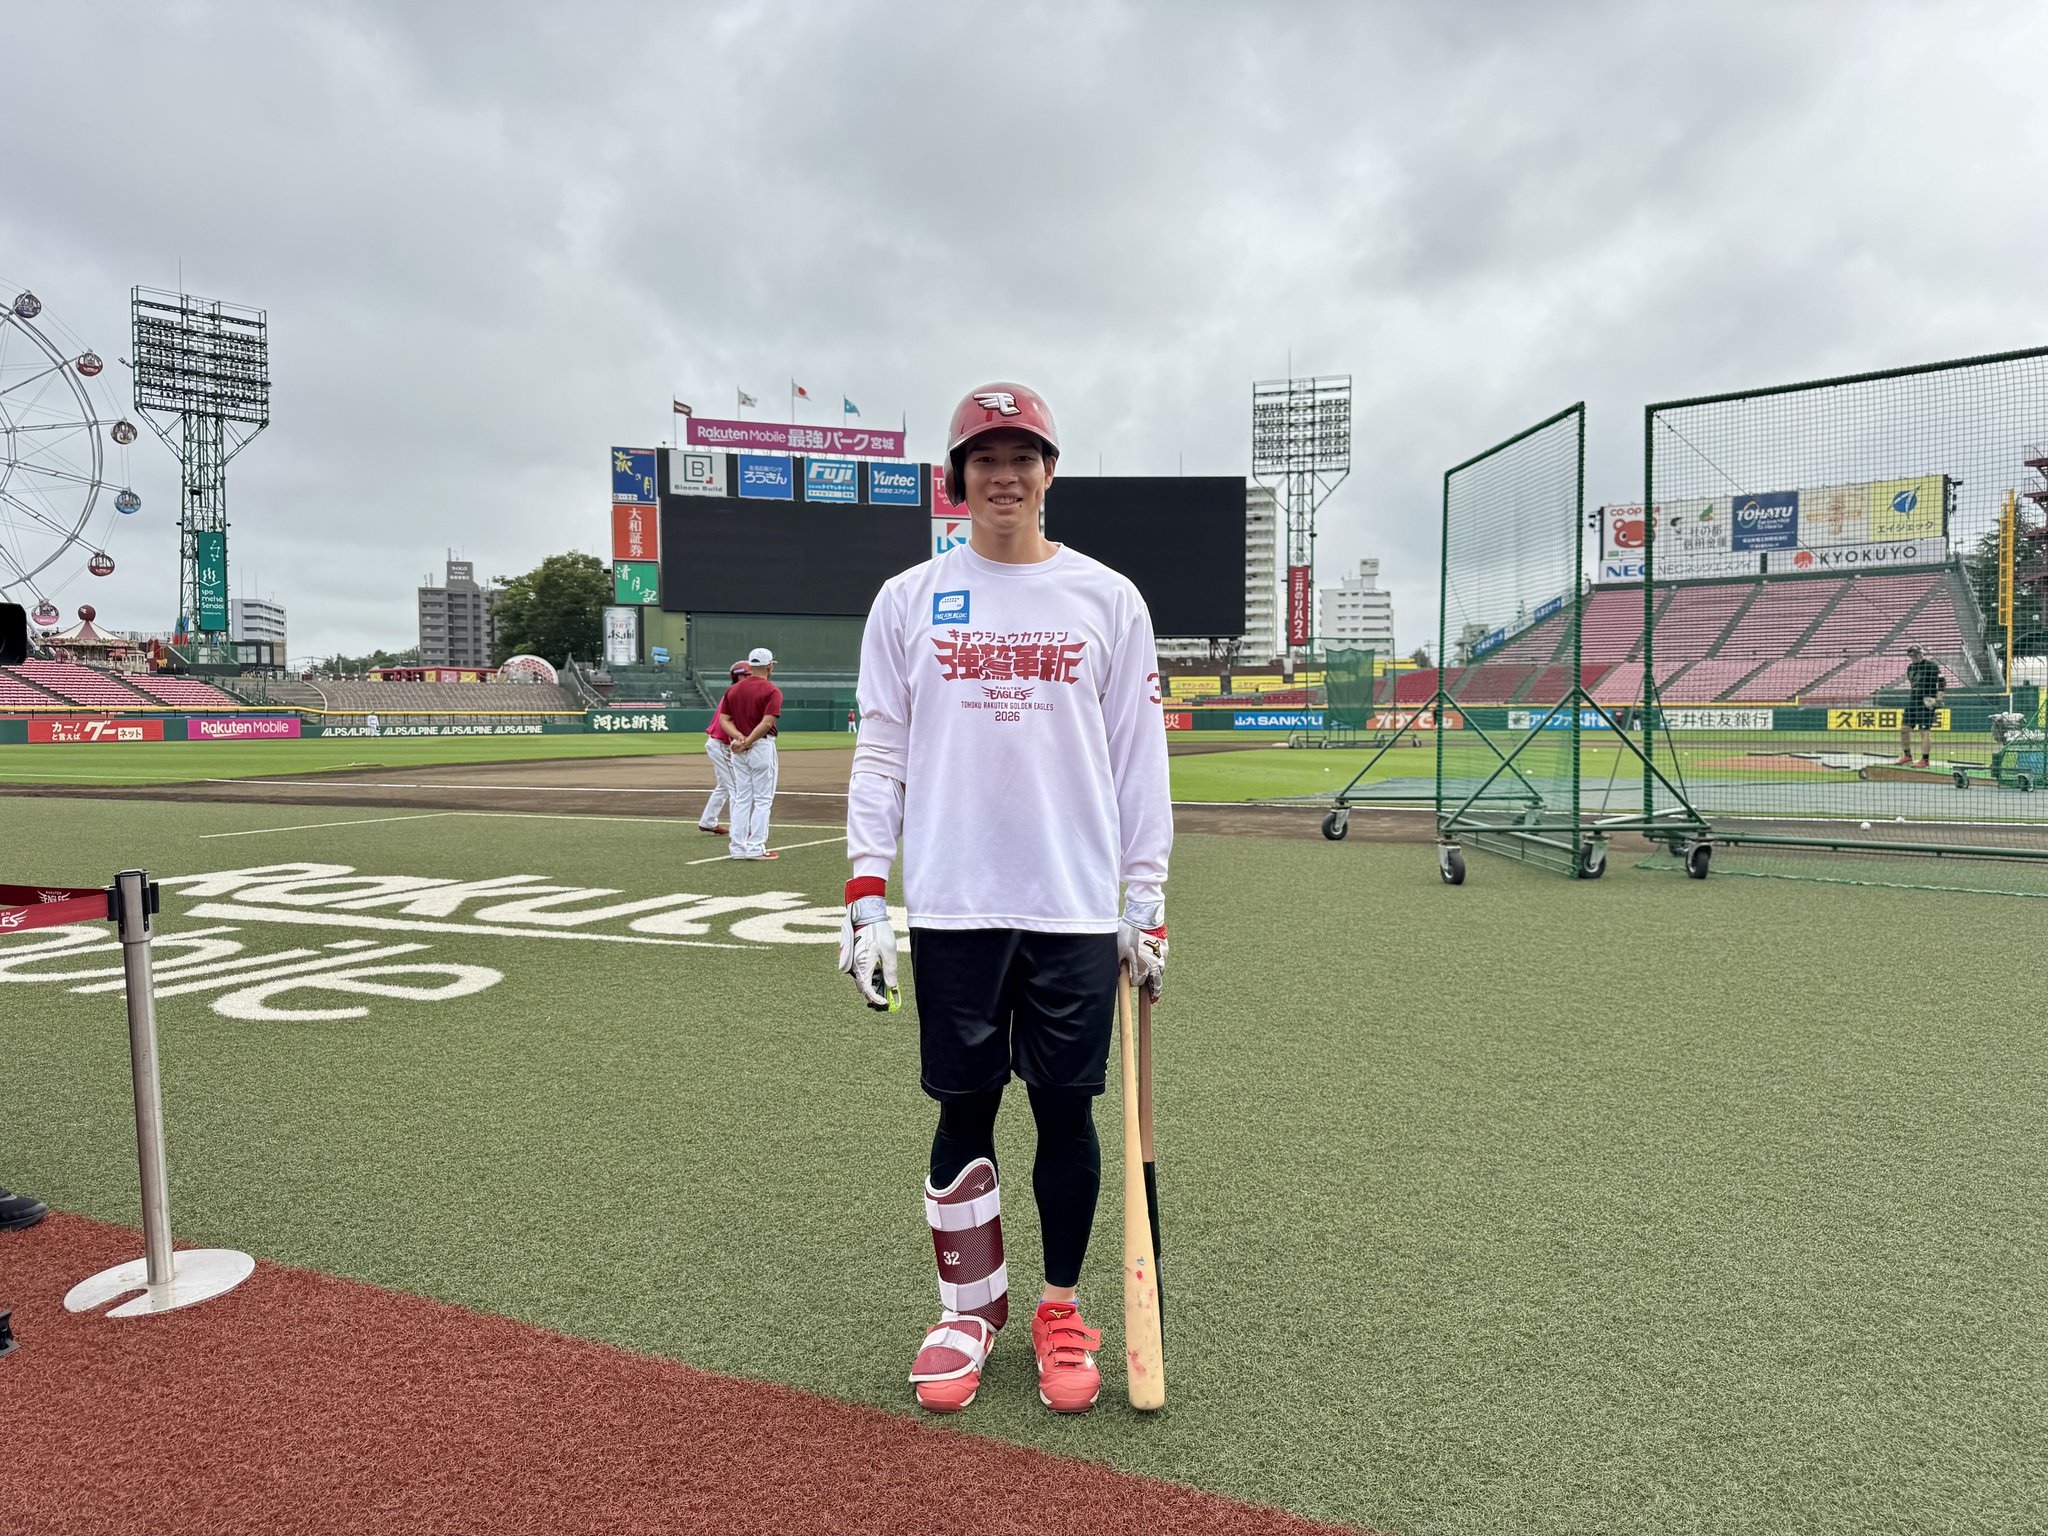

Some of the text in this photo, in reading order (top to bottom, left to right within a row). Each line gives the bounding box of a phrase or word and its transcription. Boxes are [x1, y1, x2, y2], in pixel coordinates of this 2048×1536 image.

[697, 425, 894, 450] Rakuten Mobile 最強パーク 宮城
[744, 470, 787, 485] ろうきん
[809, 462, 854, 483] Fuji
[873, 470, 916, 487] Yurtec
[629, 508, 643, 557] 大和証券
[1819, 546, 1917, 565] KYOKUYO
[1294, 571, 1304, 639] 三井のリハウス
[608, 629, 635, 640] Asahi
[947, 629, 1069, 644] キョウシュウカクシン
[986, 689, 1030, 700] EAGLES
[961, 701, 981, 709] TOHOKU
[1010, 702, 1032, 710] GOLDEN
[1034, 703, 1054, 711] EAGLES
[593, 713, 669, 731] 河北新報
[995, 711, 1020, 721] 2026
[1662, 712, 1769, 728] 三井住友銀行
[119, 729, 142, 739] ネット
[200, 721, 289, 736] Rakuten Mobile
[321, 727, 380, 736] ALPSALPI
[101, 862, 910, 951] Rakute
[943, 1251, 961, 1265] 32
